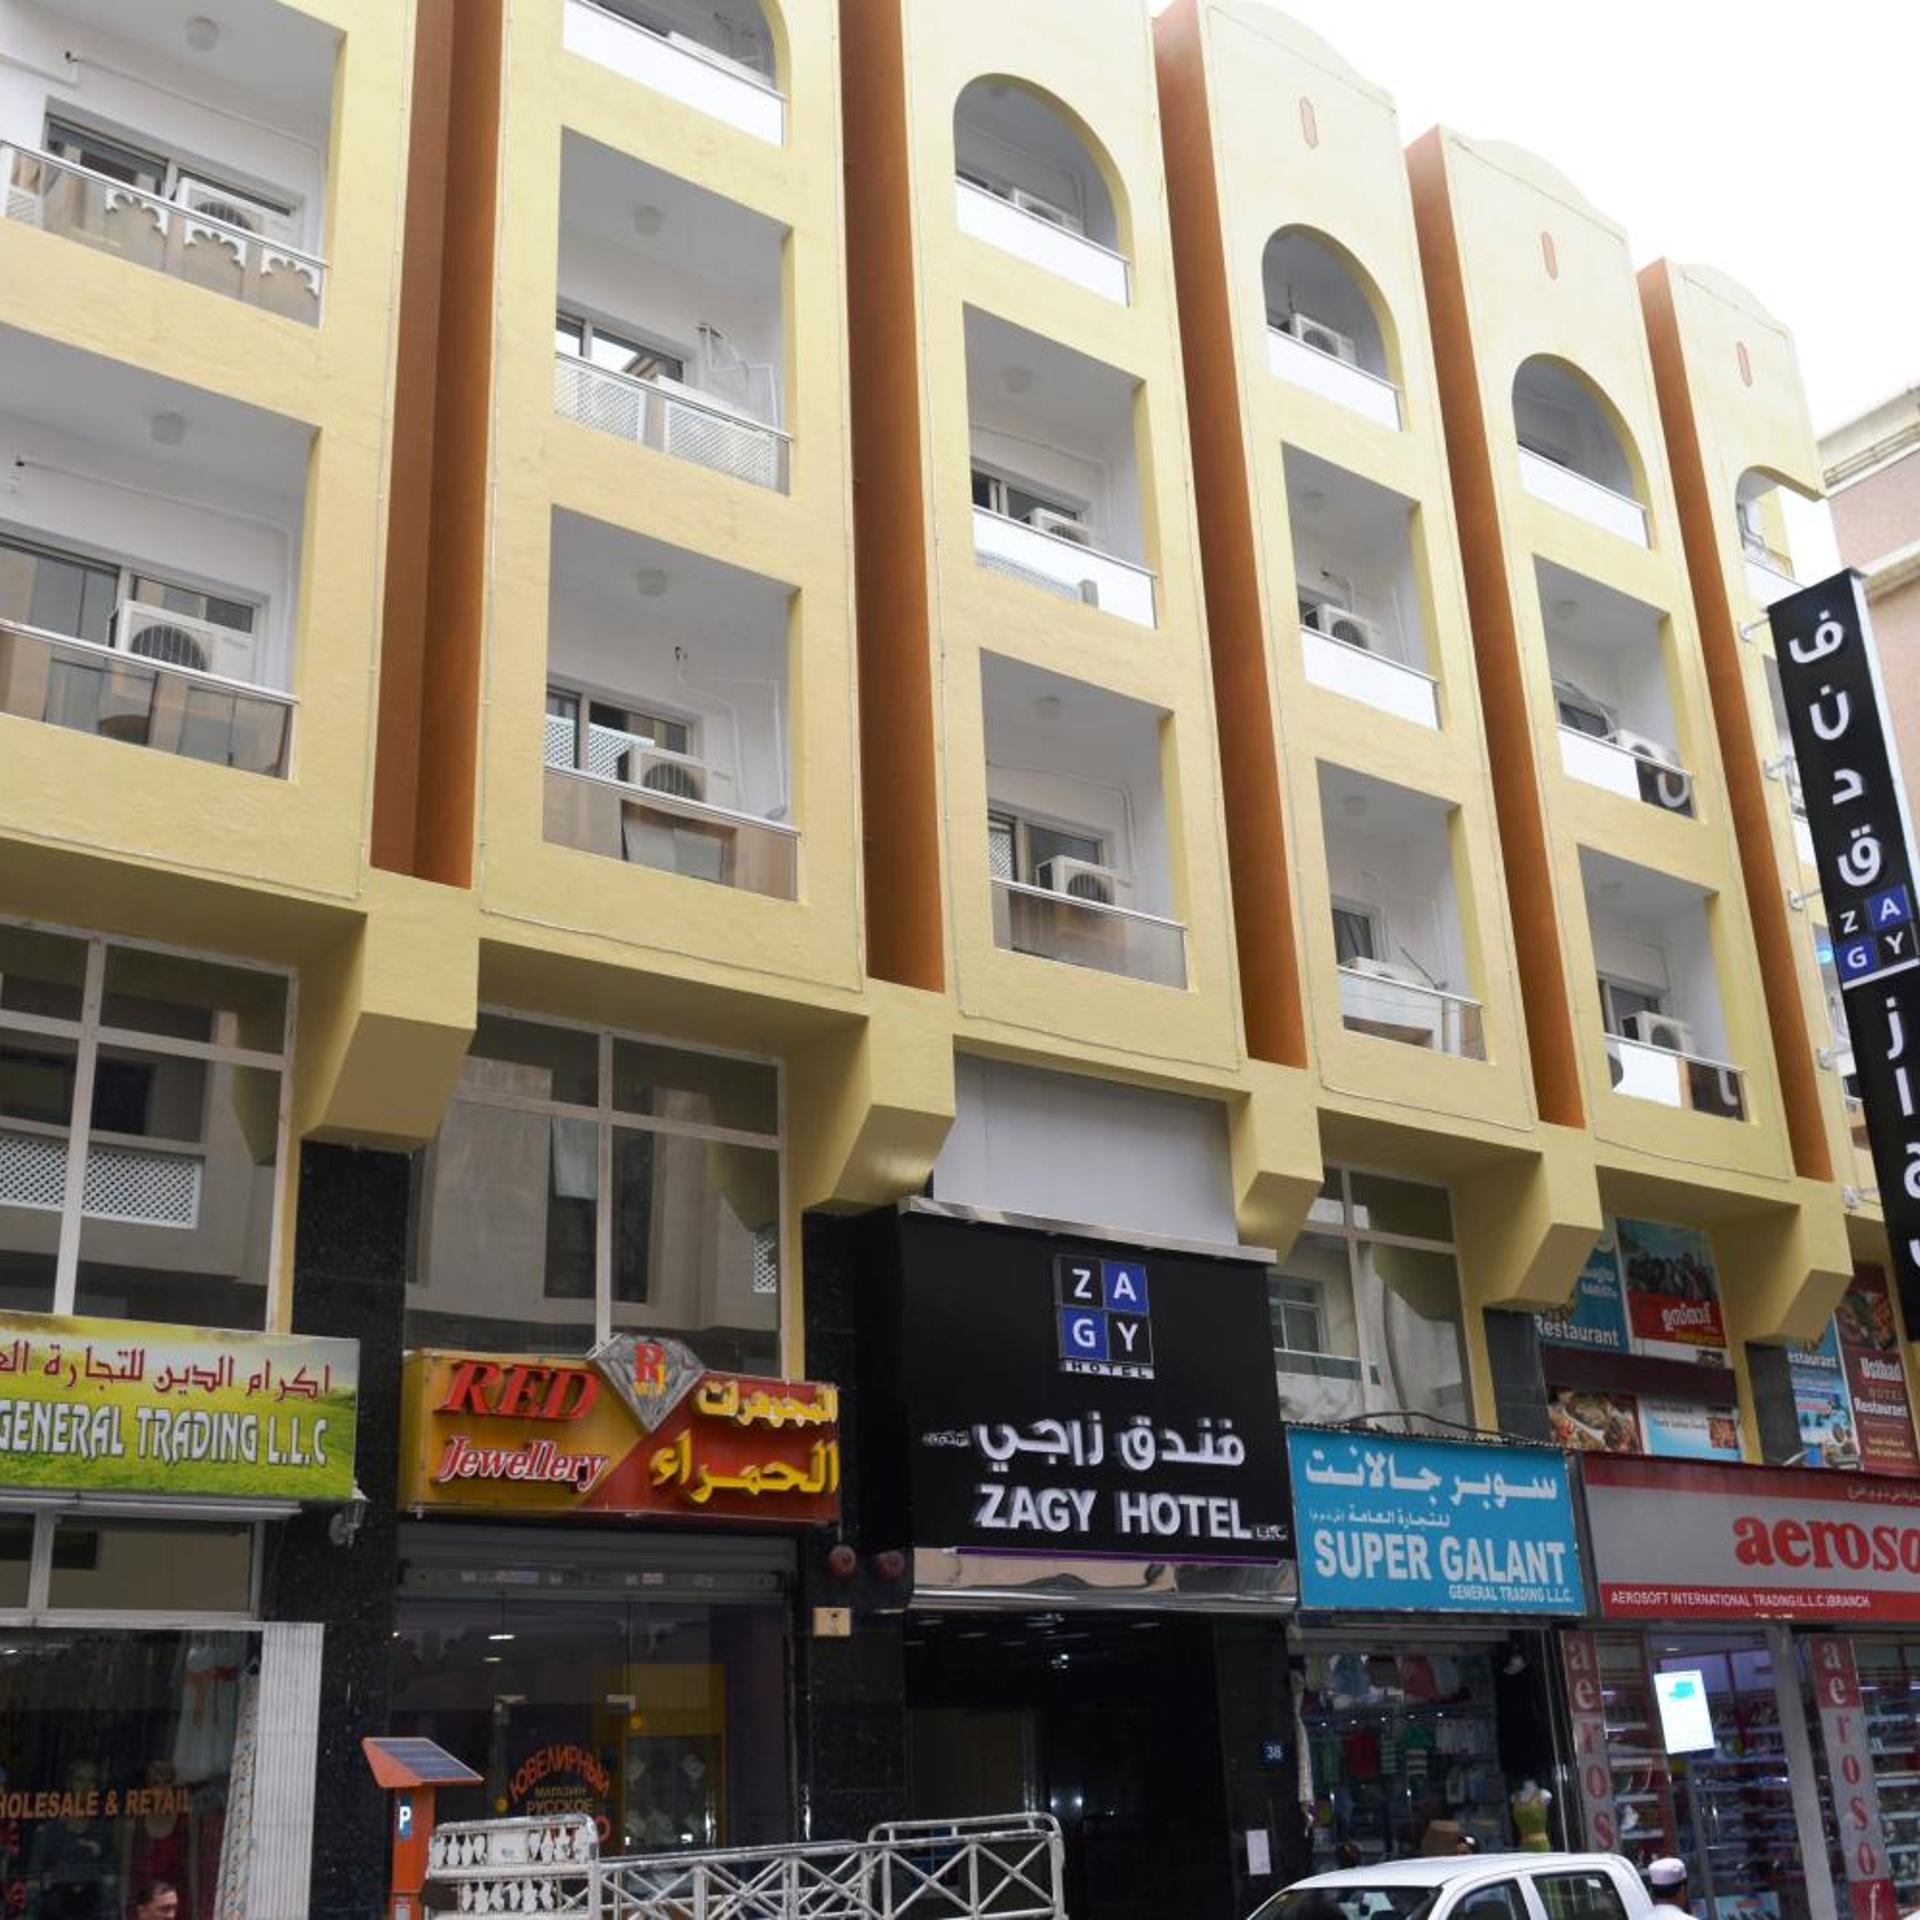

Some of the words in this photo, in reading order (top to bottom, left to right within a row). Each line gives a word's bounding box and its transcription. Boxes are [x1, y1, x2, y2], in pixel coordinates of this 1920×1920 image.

[153, 1354, 234, 1395] الدين
[434, 1359, 600, 1422] RED
[137, 1405, 258, 1465] TRADING
[973, 1411, 1104, 1473] زاجي
[1119, 1415, 1246, 1471] فندق
[435, 1435, 610, 1494] Jewellery
[649, 1430, 840, 1503] الحمراء
[975, 1484, 1097, 1533] ZAGY
[1117, 1491, 1253, 1539] HOTEL
[1313, 1529, 1433, 1581] SUPER
[1439, 1536, 1566, 1585] GALANT
[1448, 1584, 1498, 1601] GENERAL
[1499, 1586, 1545, 1603] TRADING
[1611, 1589, 1668, 1606] AEROSOFT
[1671, 1591, 1750, 1608] INTERNATIONAL
[105, 1788, 119, 1818] &
[126, 1786, 192, 1816] RETAIL
[399, 1805, 412, 1829] P
